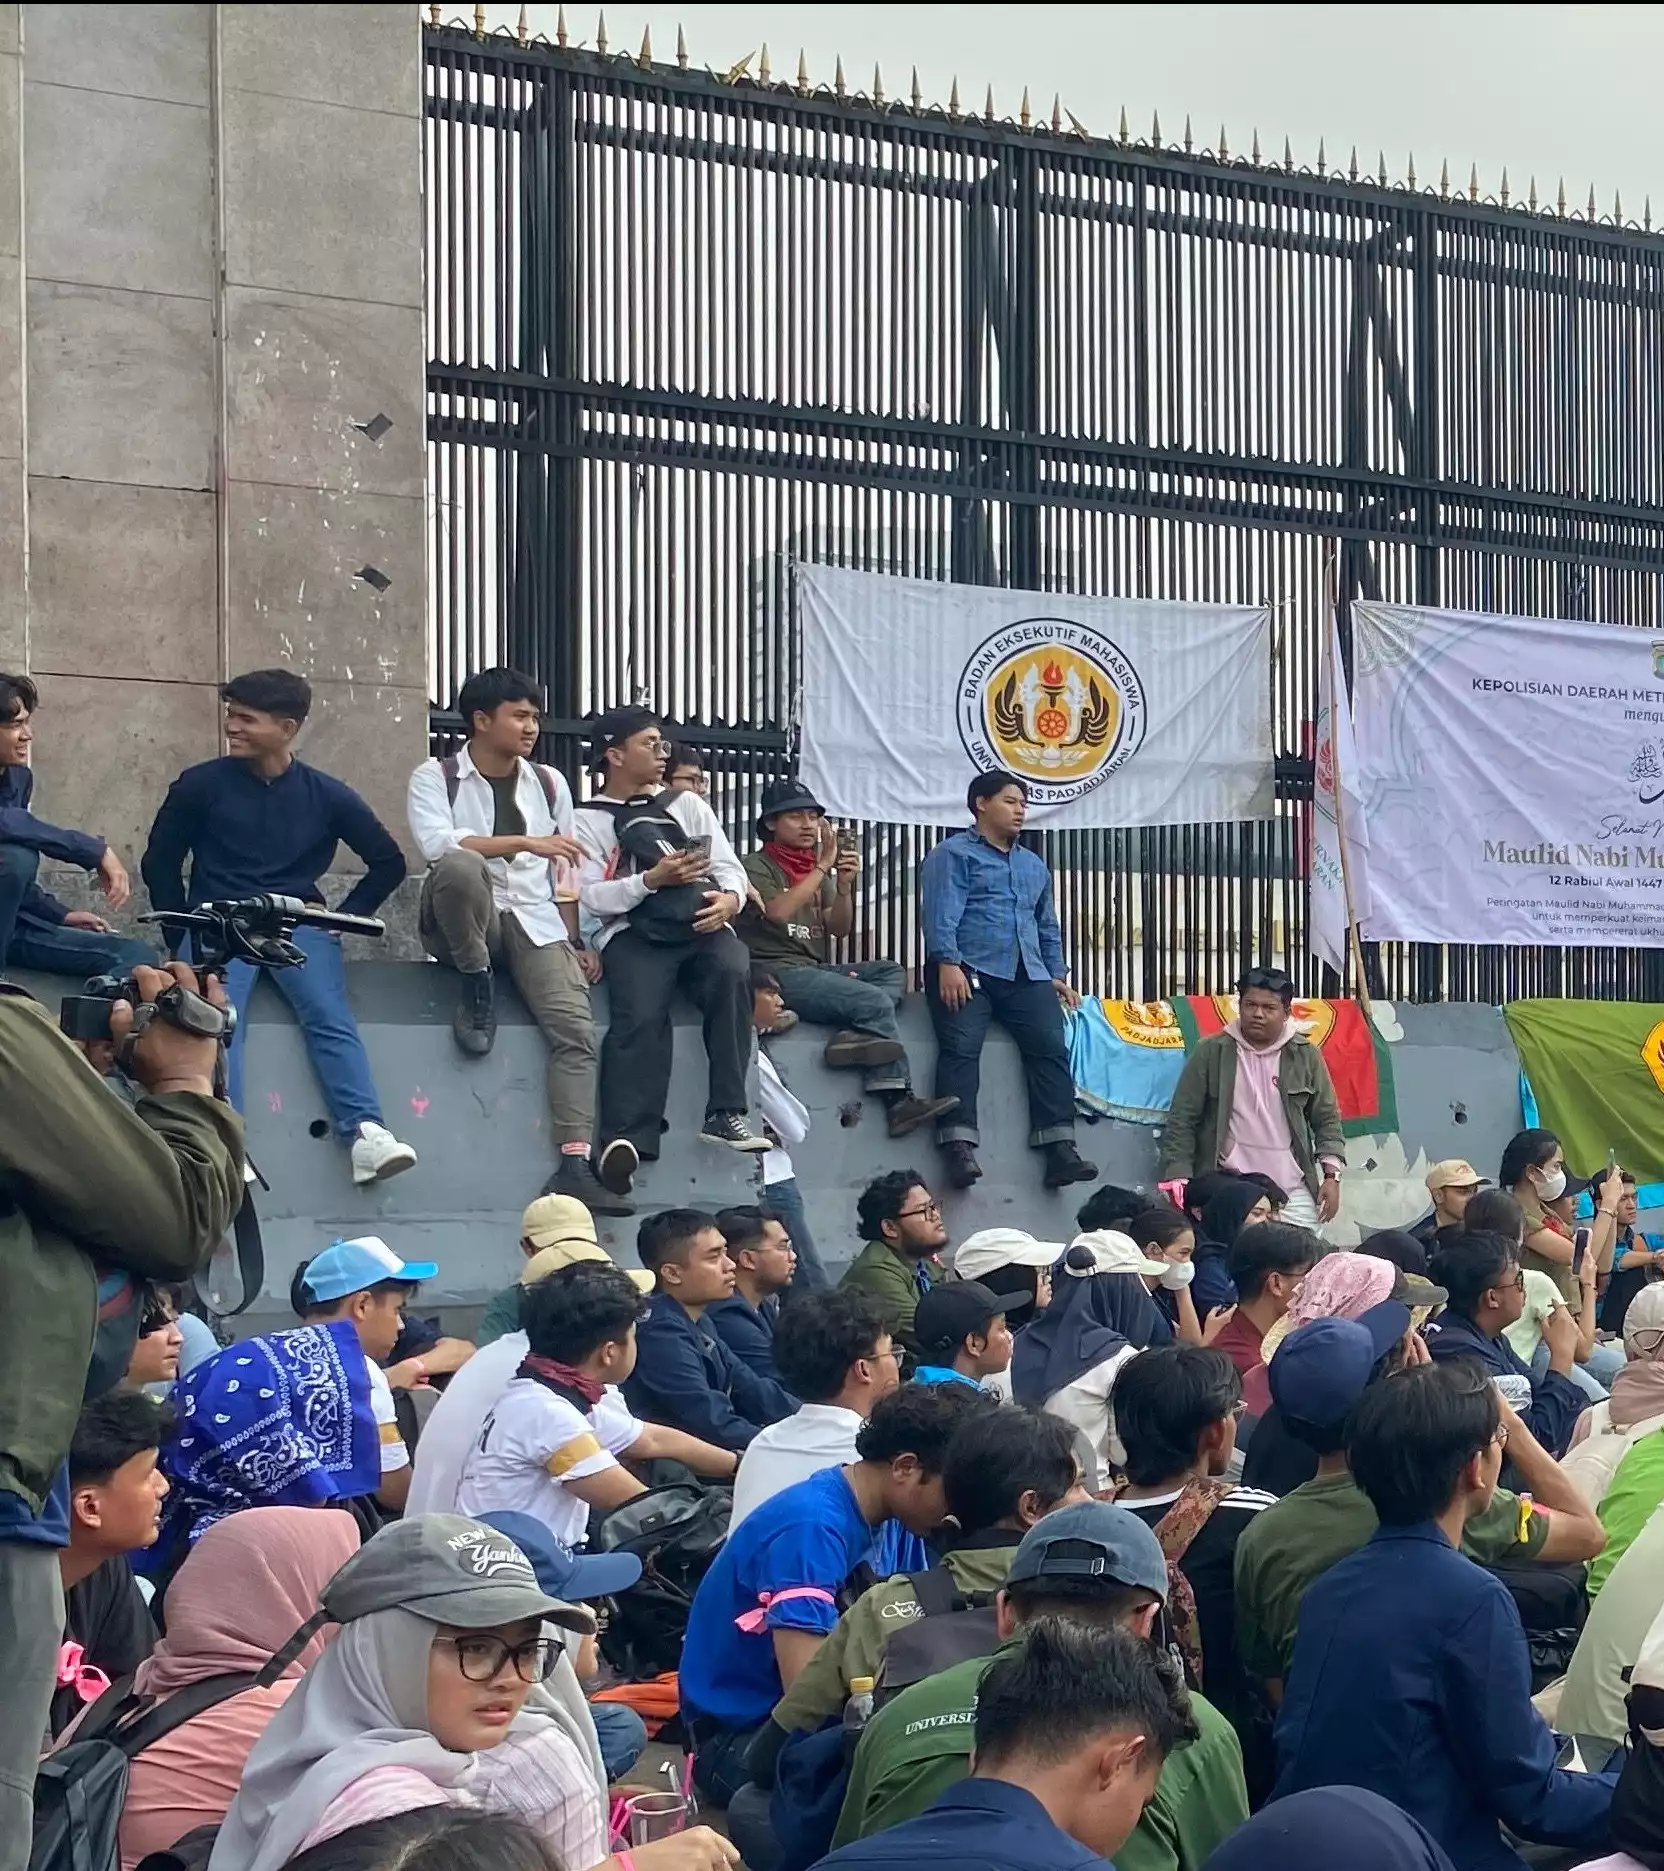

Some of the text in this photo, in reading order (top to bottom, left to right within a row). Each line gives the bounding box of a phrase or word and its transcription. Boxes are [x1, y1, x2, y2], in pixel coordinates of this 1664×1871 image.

[964, 625, 1140, 711] BADAN EKSEKUTIF MAHASISWA
[1472, 677, 1563, 697] KEPOLISIAN
[1567, 684, 1628, 701] DAERAH
[1596, 814, 1651, 840] Selamat
[1482, 838, 1571, 866] Maulid
[1576, 843, 1629, 868] Nabi
[1549, 875, 1562, 886] 12
[1564, 876, 1603, 887] Rabiul
[1606, 877, 1634, 888] Awal
[1637, 878, 1663, 889] 1447
[1486, 897, 1543, 910] Peringatan
[1545, 898, 1580, 909] Maulid
[1582, 899, 1606, 910] Nabi
[1532, 912, 1562, 921] untuk
[1564, 913, 1630, 924] memperkuat
[1549, 926, 1574, 935] serta
[447, 1528, 486, 1551] NEW
